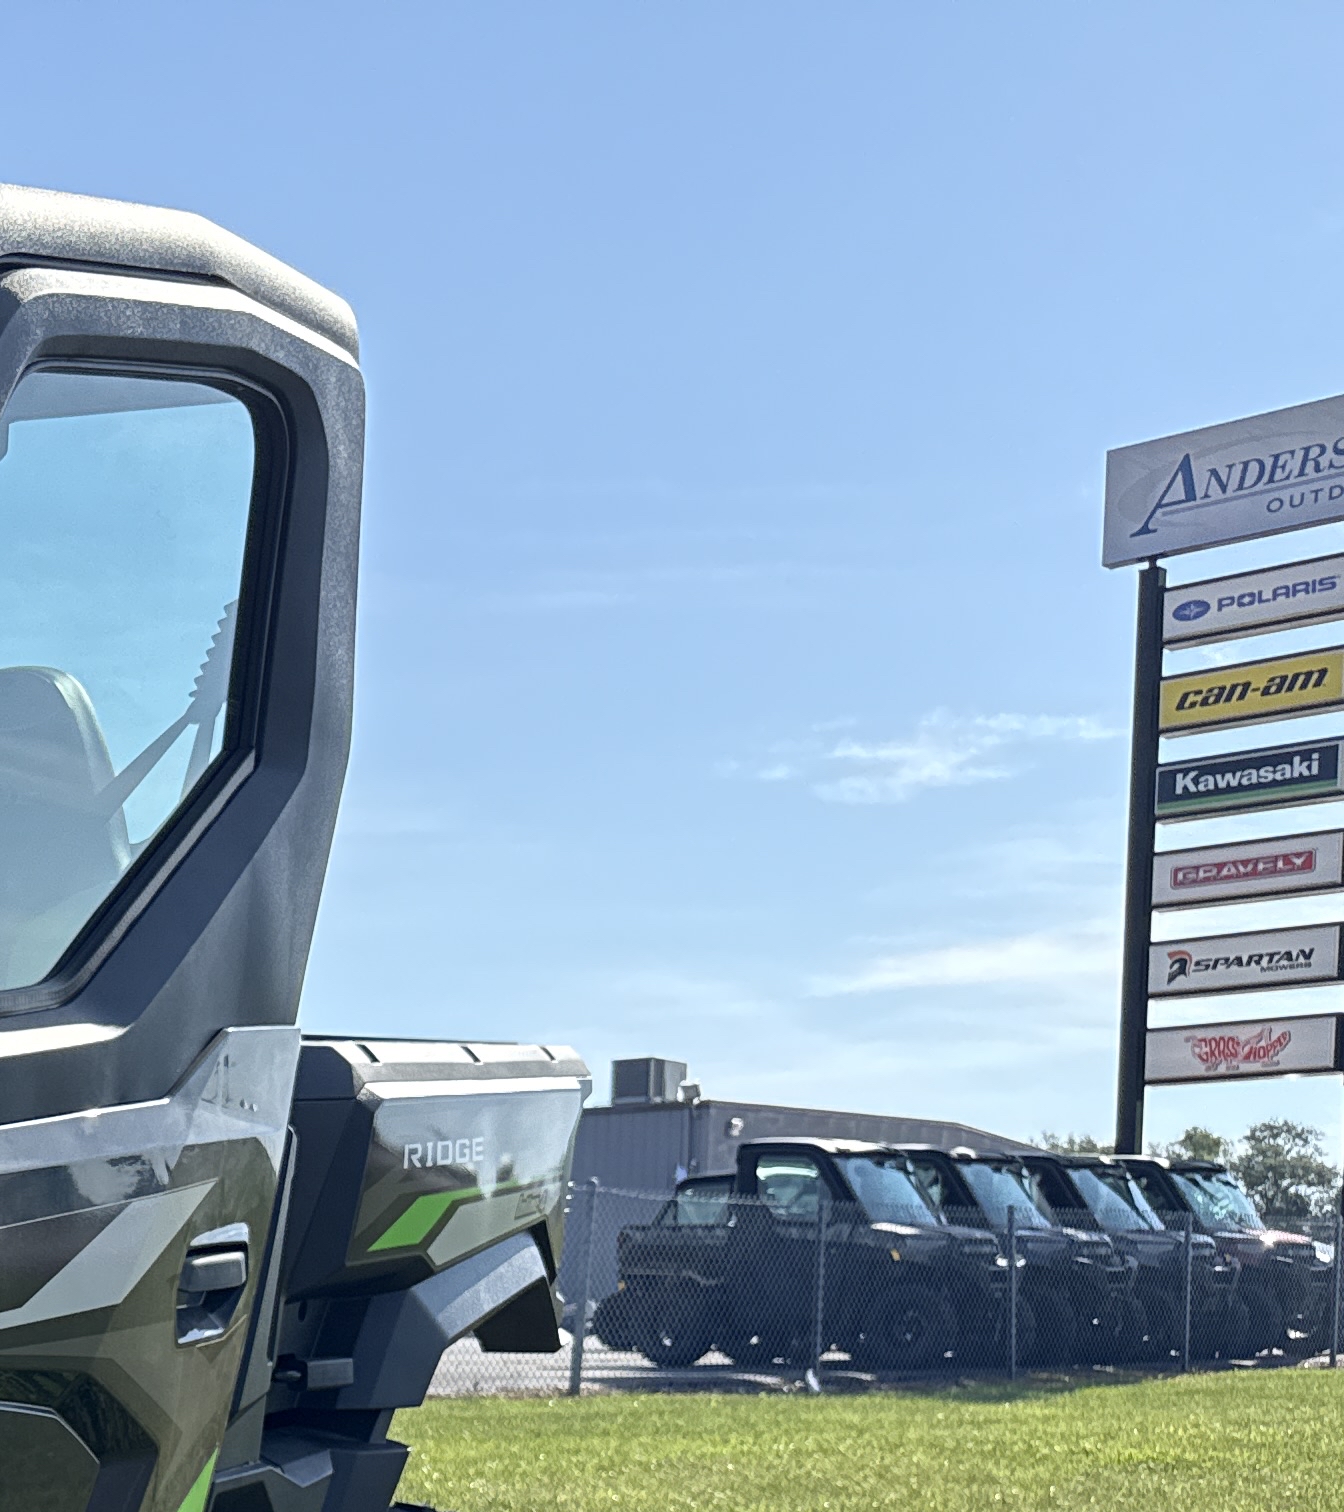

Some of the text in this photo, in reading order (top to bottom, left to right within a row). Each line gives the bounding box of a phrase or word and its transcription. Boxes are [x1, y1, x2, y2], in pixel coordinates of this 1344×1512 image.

[1216, 575, 1338, 612] POLARIS
[1175, 667, 1329, 712] can-am
[1174, 752, 1320, 795] Kawasaki
[1176, 852, 1308, 884] GRAVELY
[1192, 947, 1315, 974] SPARTAN
[1260, 960, 1313, 974] MOWERS
[403, 1136, 485, 1169] RIDGE
